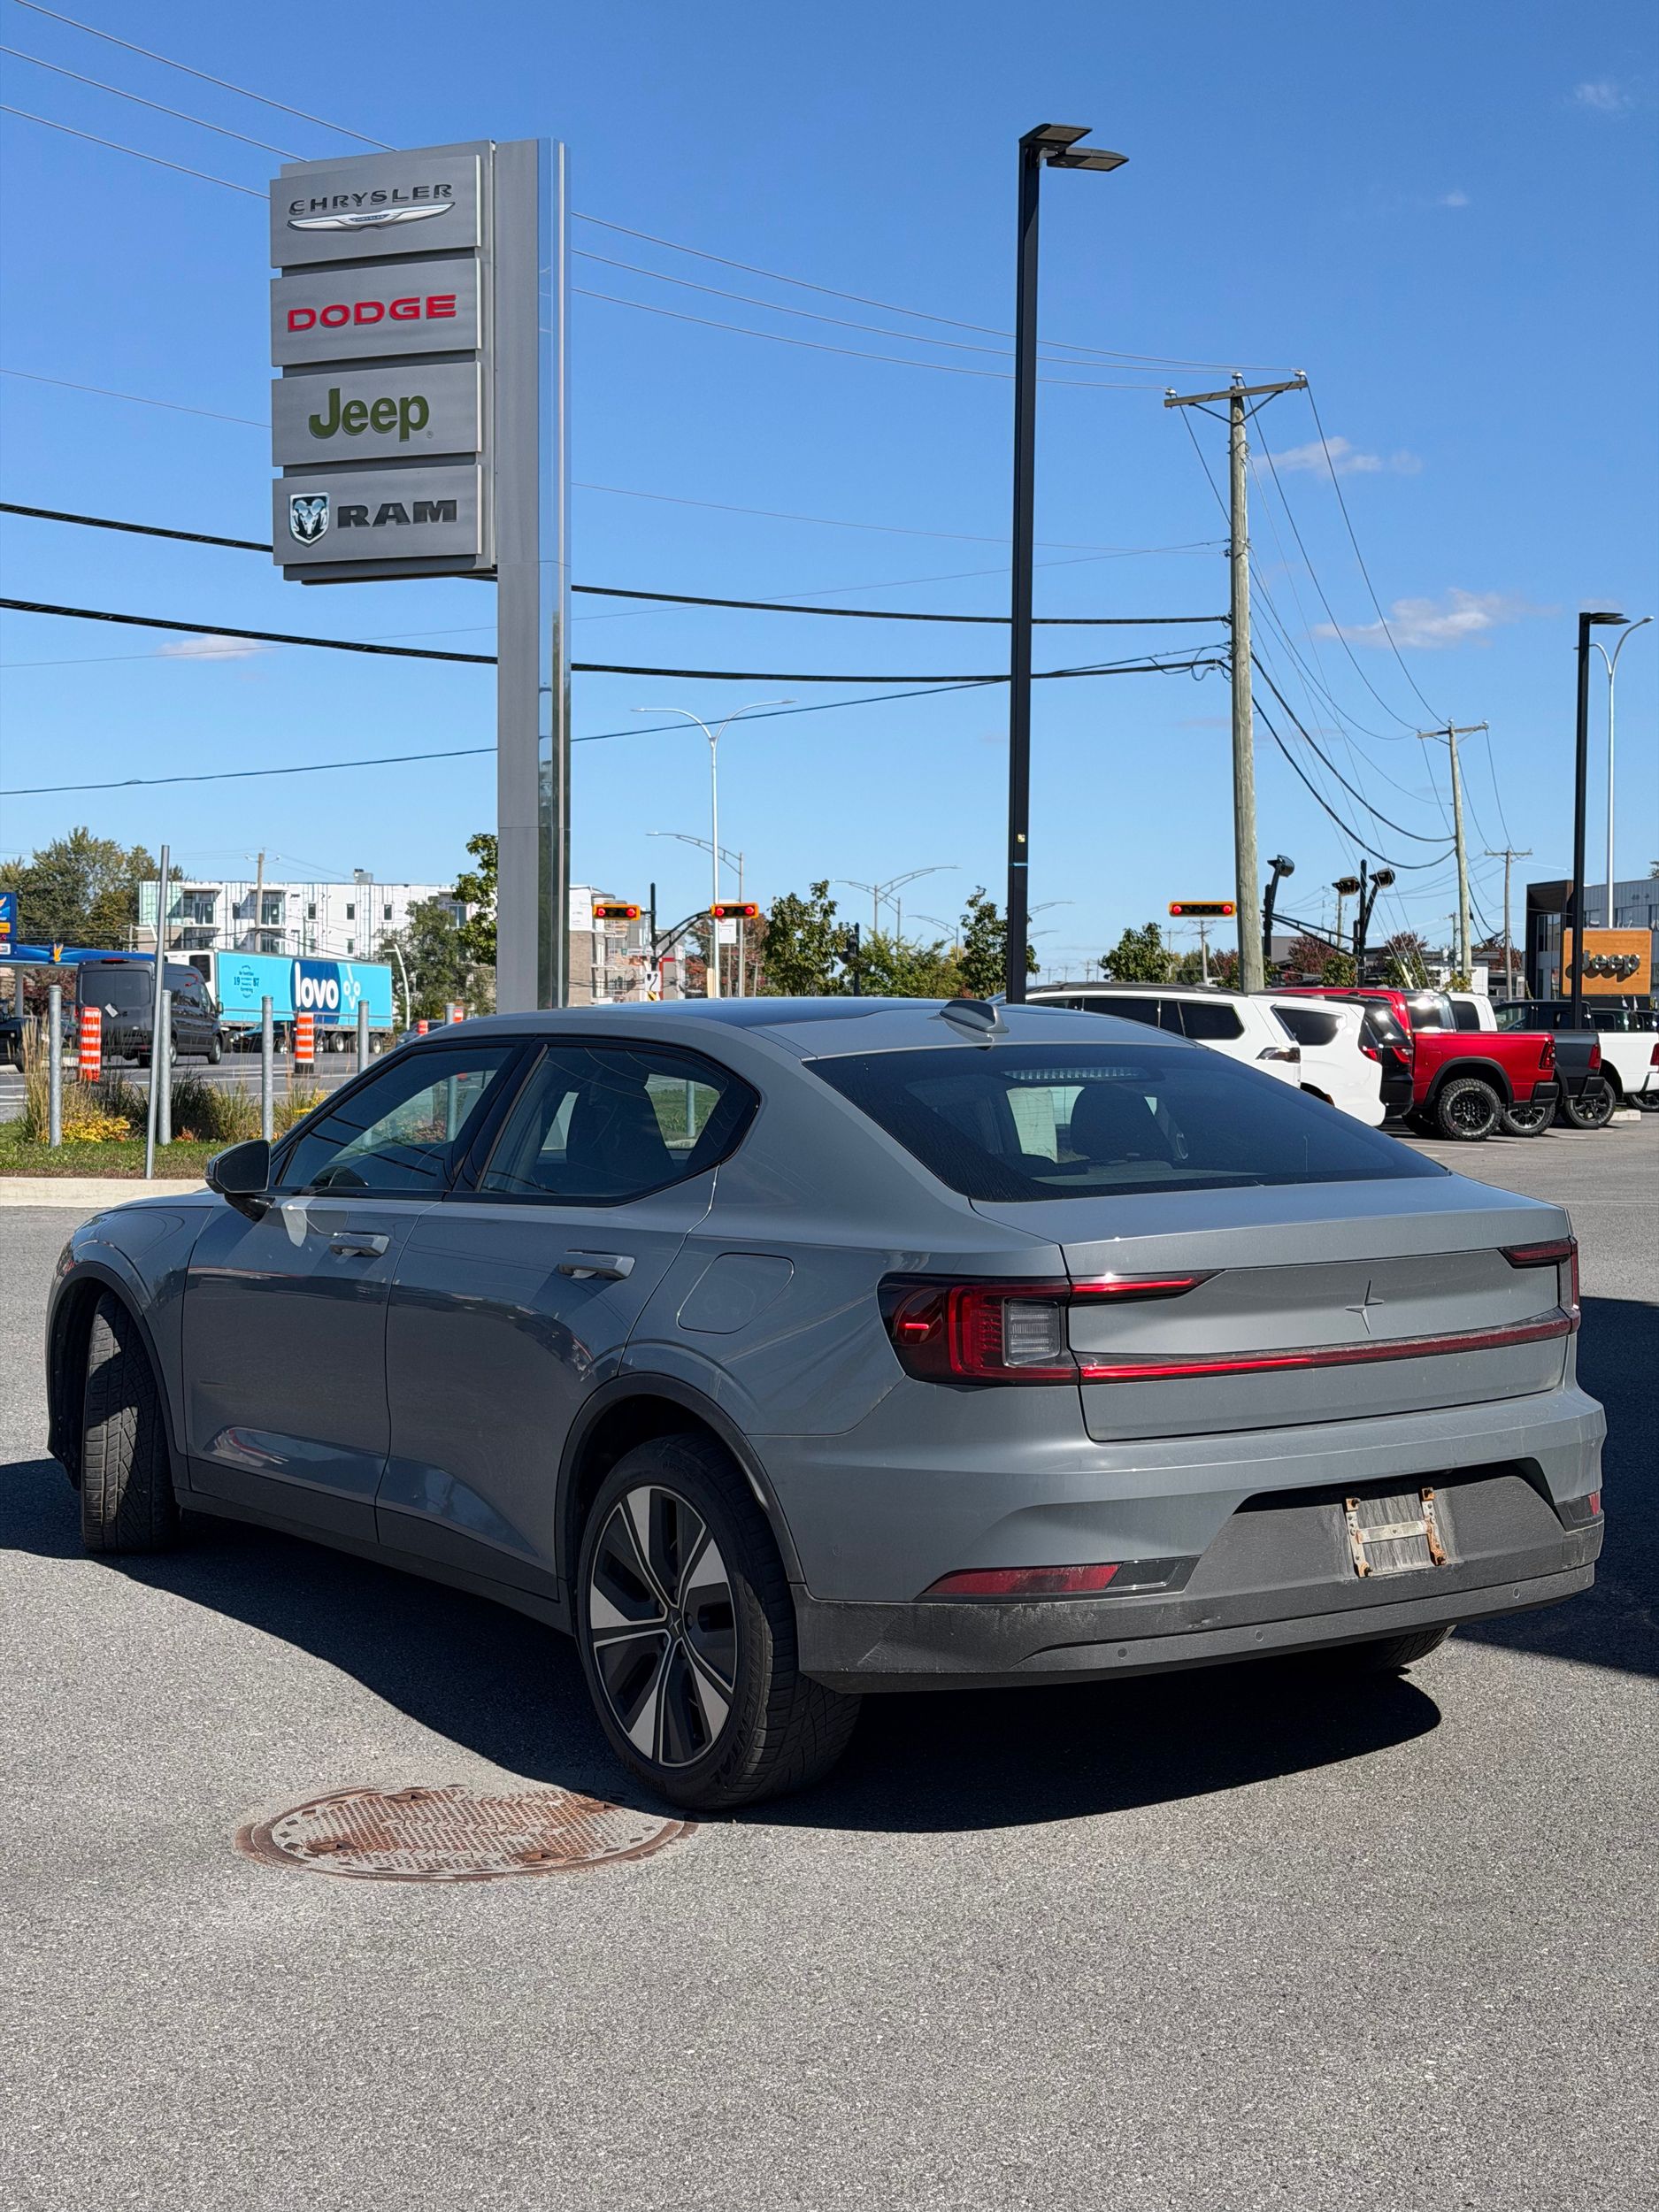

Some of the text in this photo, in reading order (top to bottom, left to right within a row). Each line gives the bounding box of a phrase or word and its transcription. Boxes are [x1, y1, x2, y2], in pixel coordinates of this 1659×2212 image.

[288, 184, 453, 215] CHRYSLER
[288, 295, 457, 333] DODGE
[309, 388, 429, 442] Jeep
[337, 500, 457, 528] RAM
[295, 962, 339, 1010] lovo
